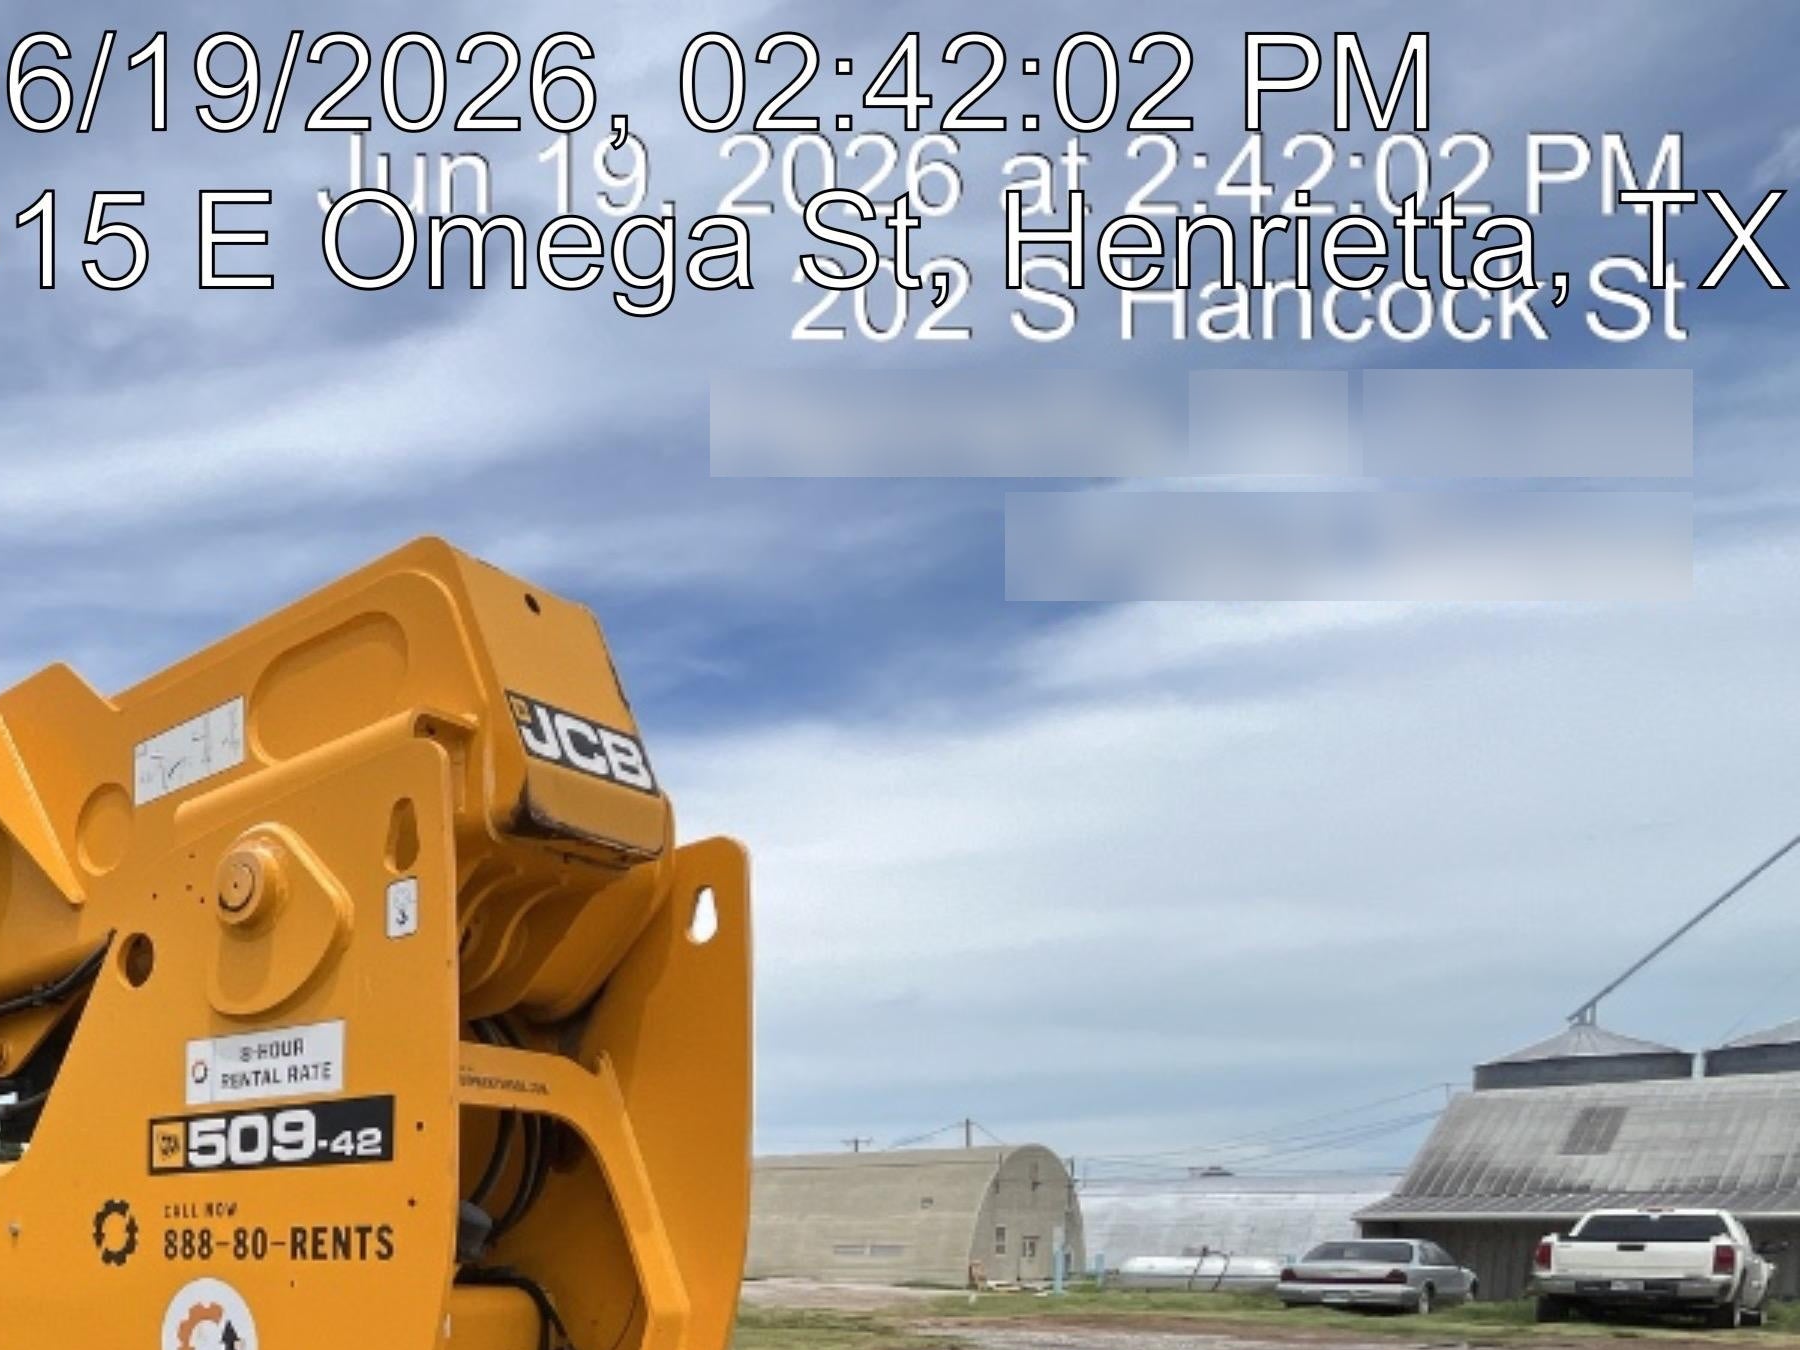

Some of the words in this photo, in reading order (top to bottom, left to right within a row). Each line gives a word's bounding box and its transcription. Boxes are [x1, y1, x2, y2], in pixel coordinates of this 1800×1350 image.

[519, 703, 653, 790] JCB
[240, 1038, 304, 1062] 8-HOUR
[221, 1070, 281, 1089] RENTAL
[288, 1061, 332, 1083] RATE
[187, 1109, 382, 1168] 509-42
[164, 1203, 198, 1218] CALL
[205, 1202, 237, 1217] NOW
[164, 1224, 394, 1260] 888-80-RENTS
